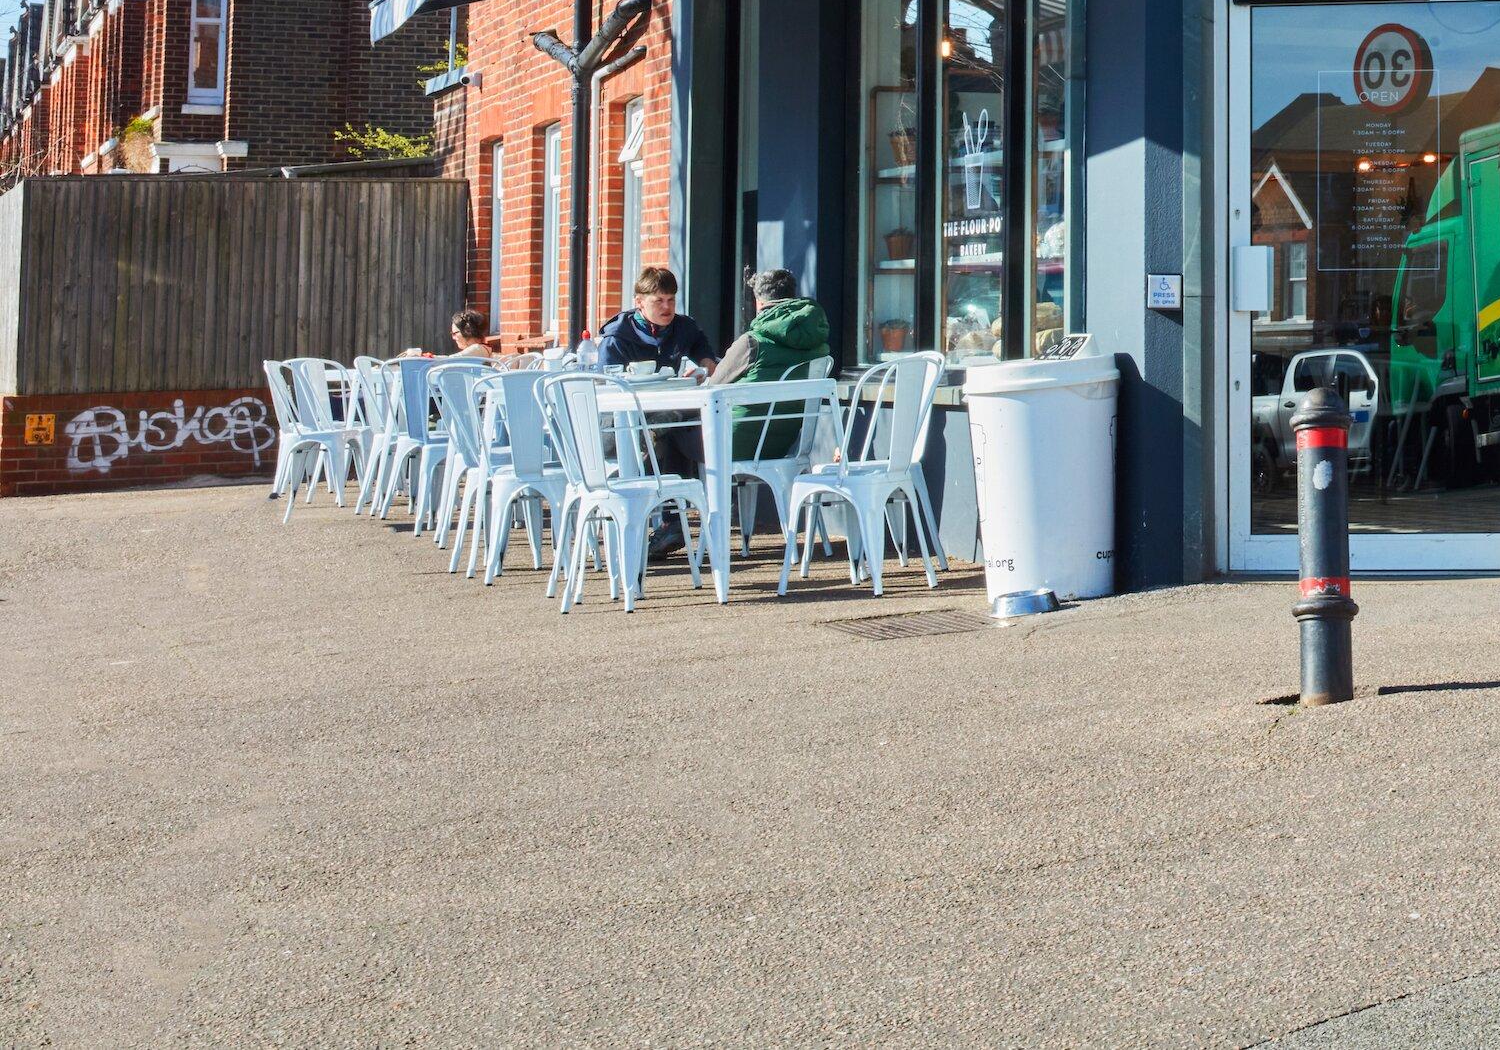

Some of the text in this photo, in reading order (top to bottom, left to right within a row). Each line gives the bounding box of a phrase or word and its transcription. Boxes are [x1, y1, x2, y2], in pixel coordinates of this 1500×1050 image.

[1360, 91, 1400, 102] OPEN
[943, 221, 959, 238] THE
[960, 218, 987, 236] FLOUR
[960, 243, 987, 256] BAKERY
